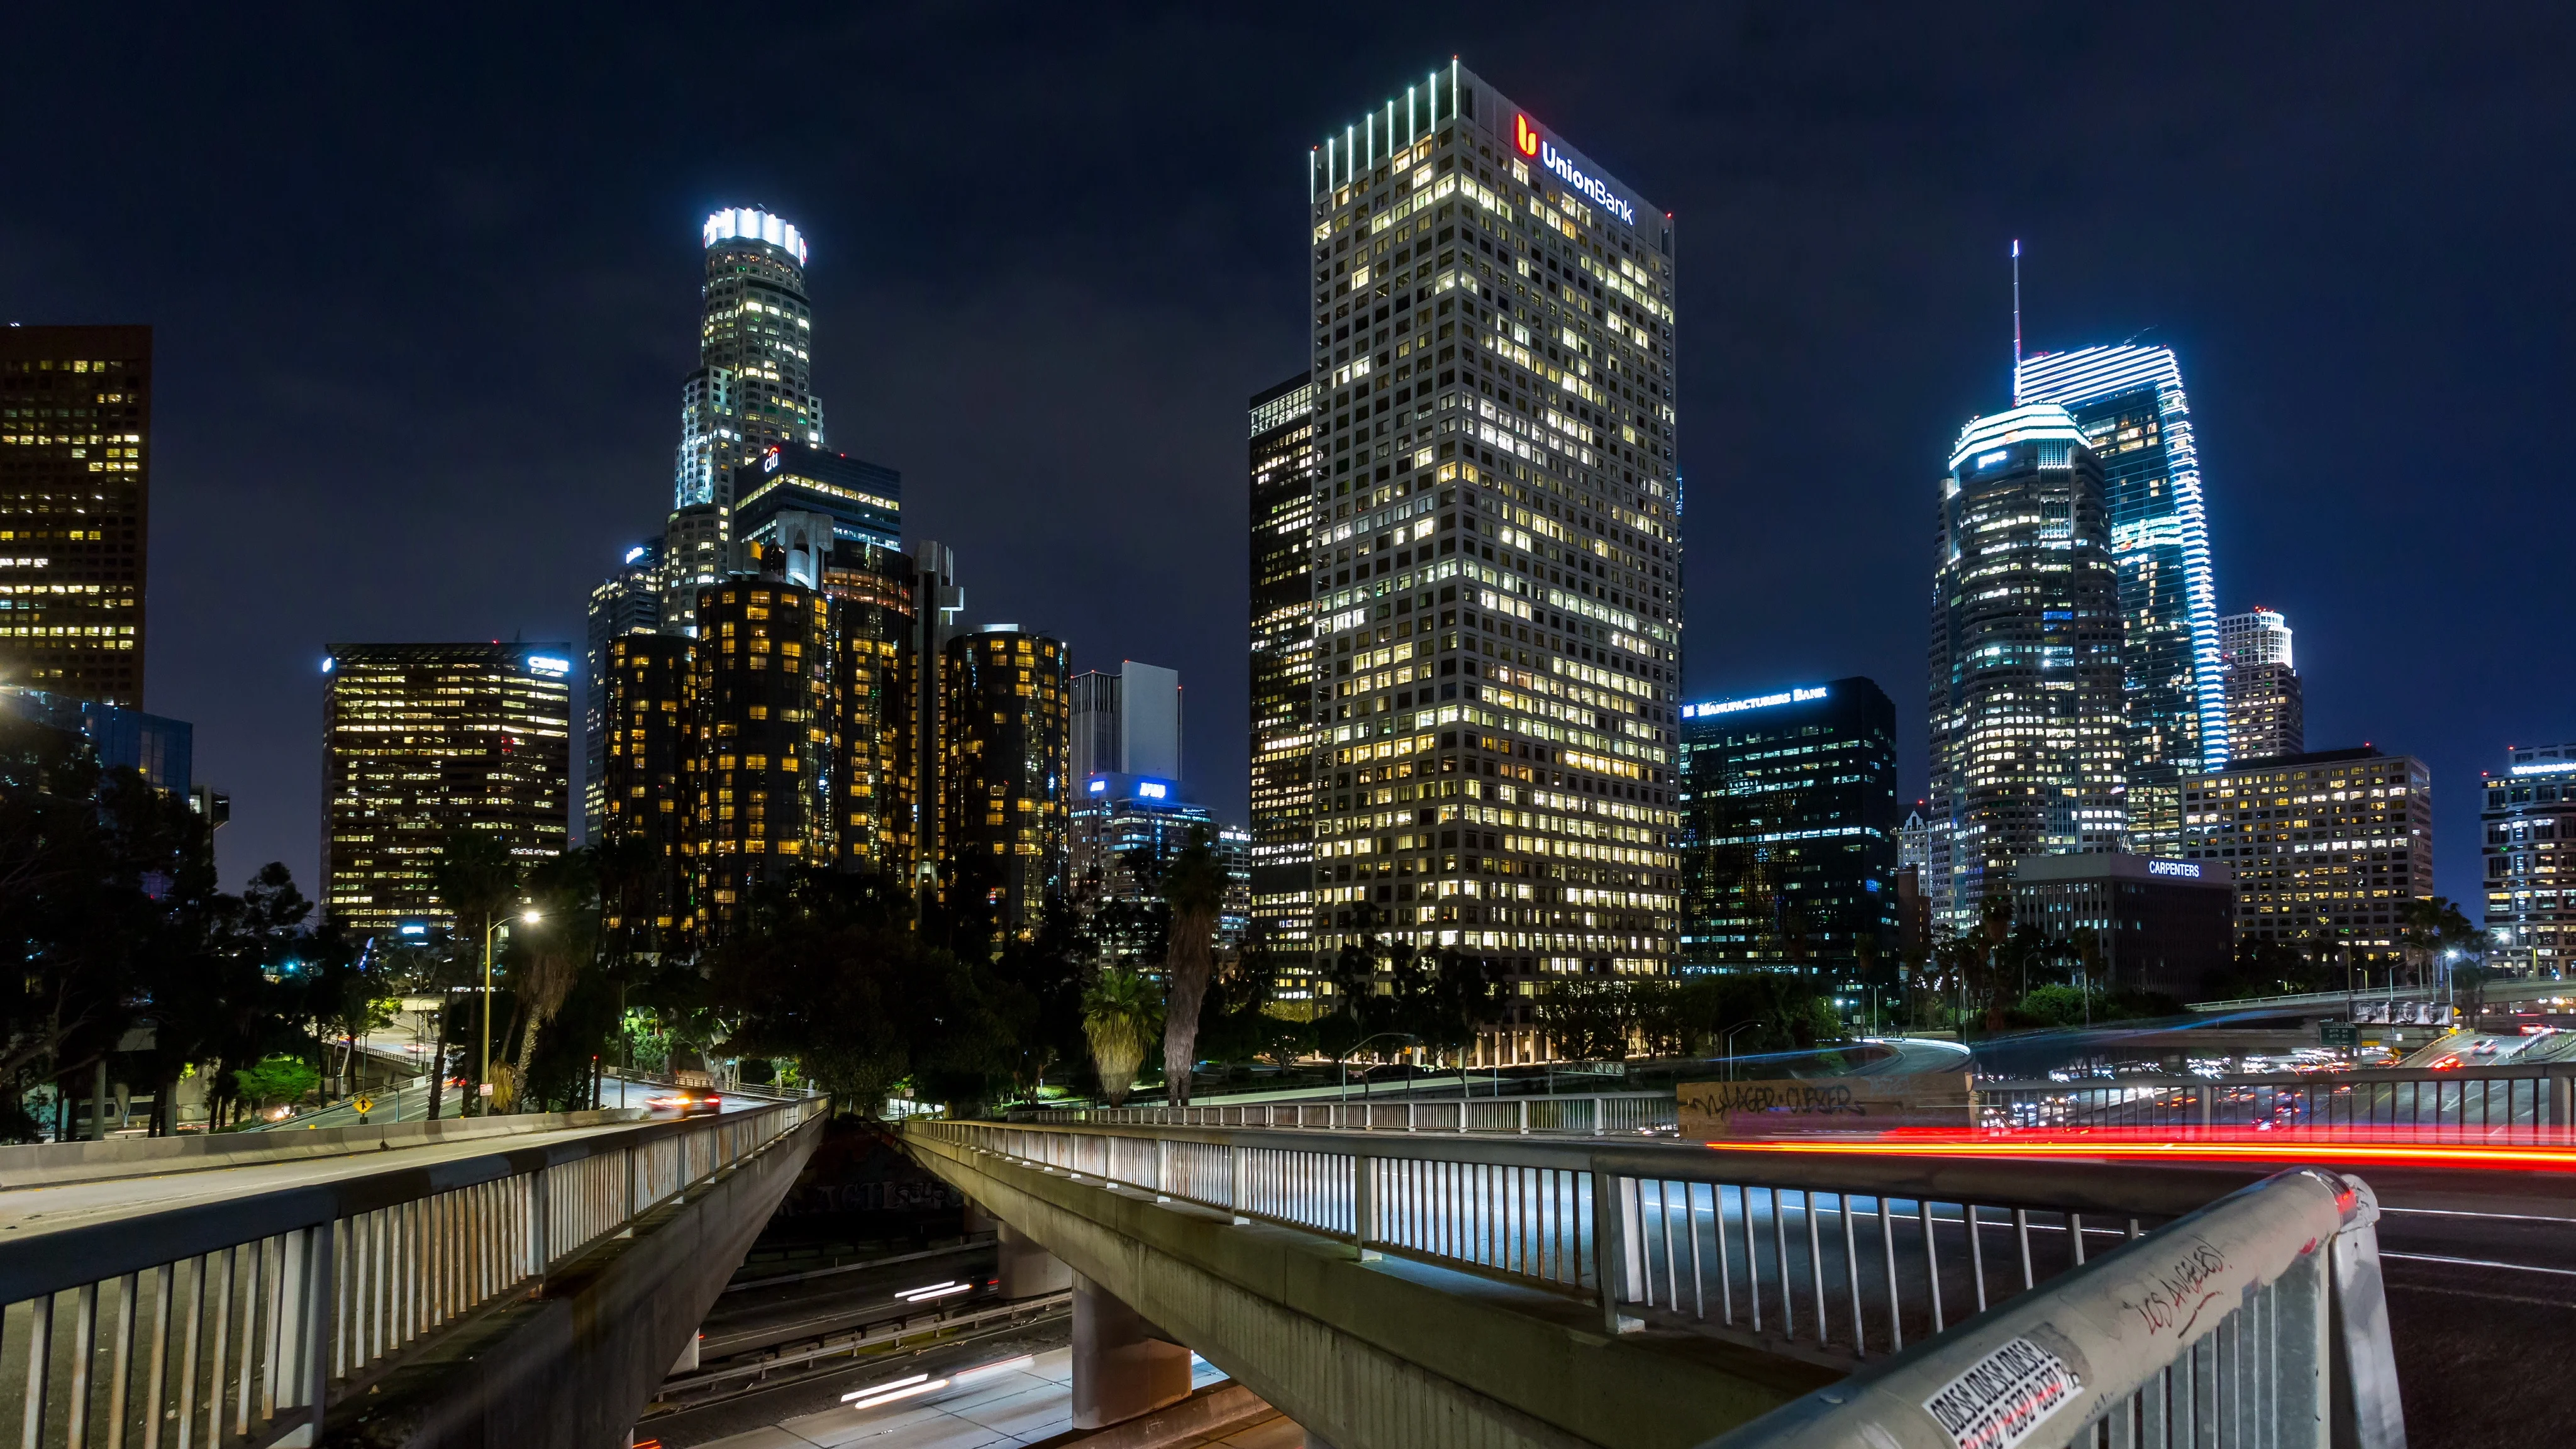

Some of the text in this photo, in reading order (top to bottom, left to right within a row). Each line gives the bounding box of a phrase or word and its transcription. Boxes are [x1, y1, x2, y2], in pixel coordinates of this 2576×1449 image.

[1542, 140, 1633, 226] UnionBank
[1793, 687, 1827, 702] BANK
[2149, 860, 2199, 878] CARPENTERS
